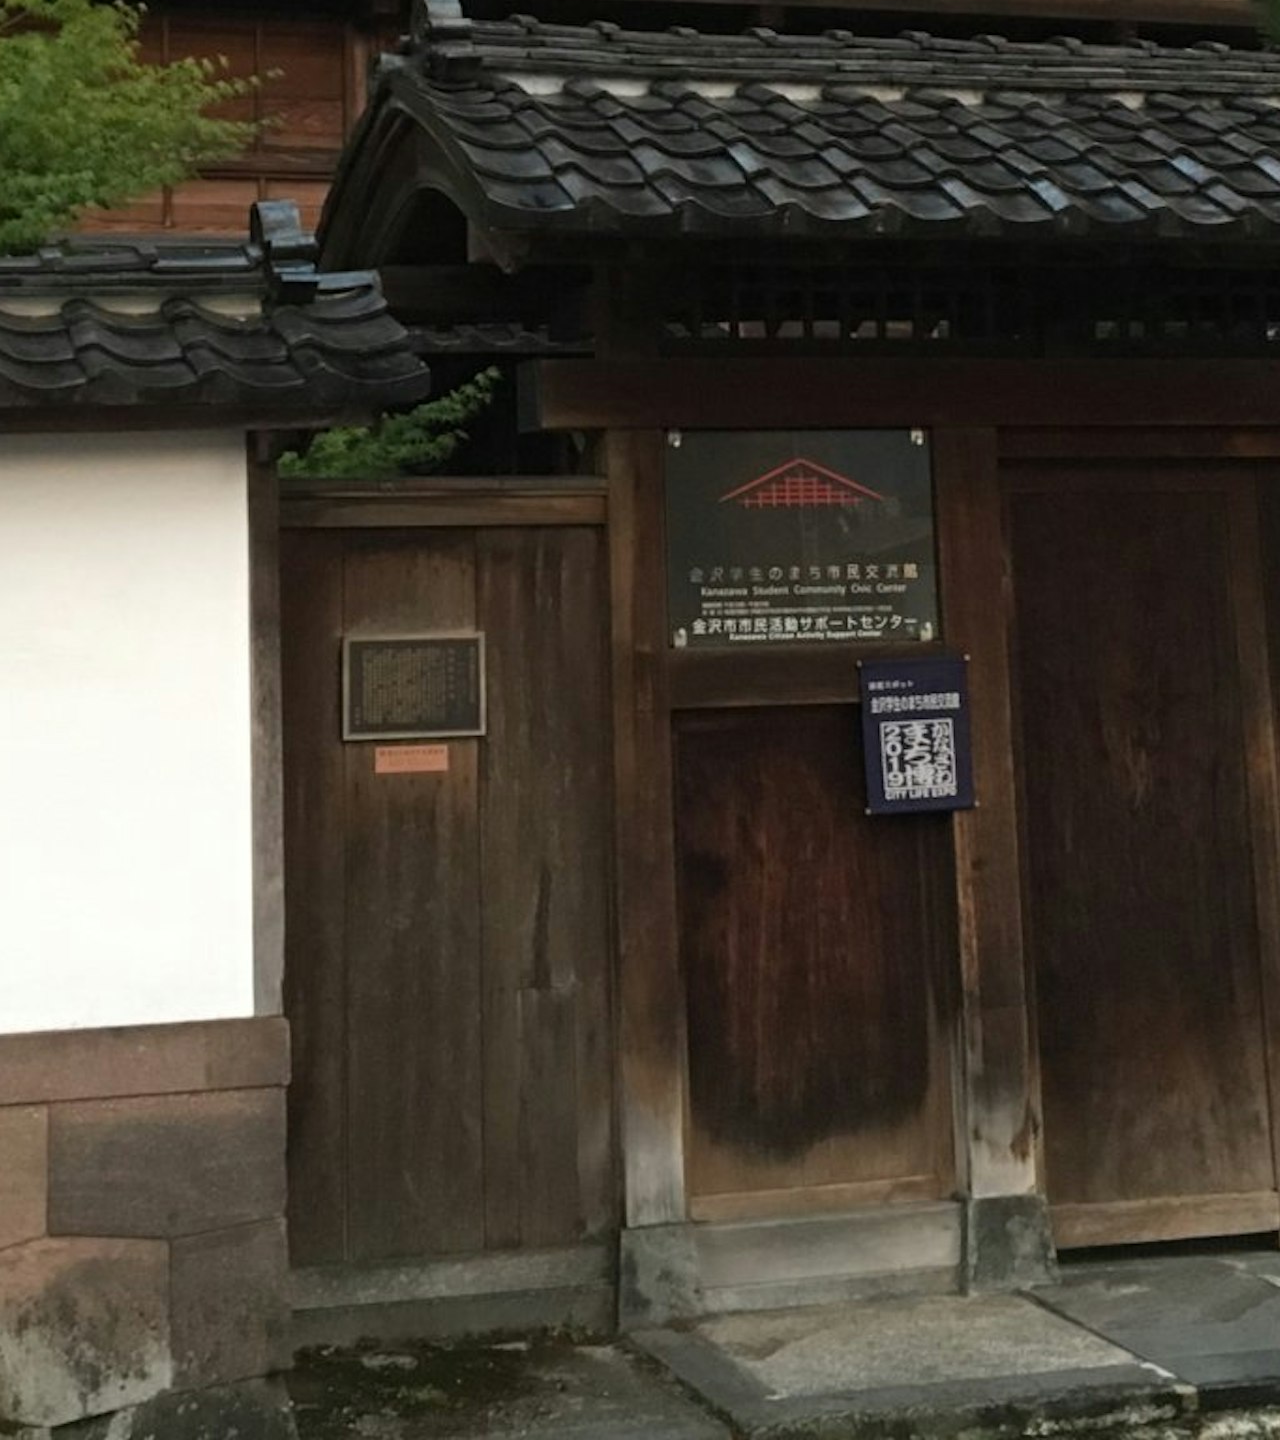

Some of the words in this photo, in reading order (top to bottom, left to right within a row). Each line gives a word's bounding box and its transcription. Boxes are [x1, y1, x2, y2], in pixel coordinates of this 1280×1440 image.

[701, 586, 748, 597] Kanazawa
[752, 585, 789, 596] Student
[793, 584, 846, 596] Community
[876, 582, 907, 593] Center
[692, 614, 918, 635] 金沢市市民活動サポートセンター
[885, 725, 905, 787] 2019
